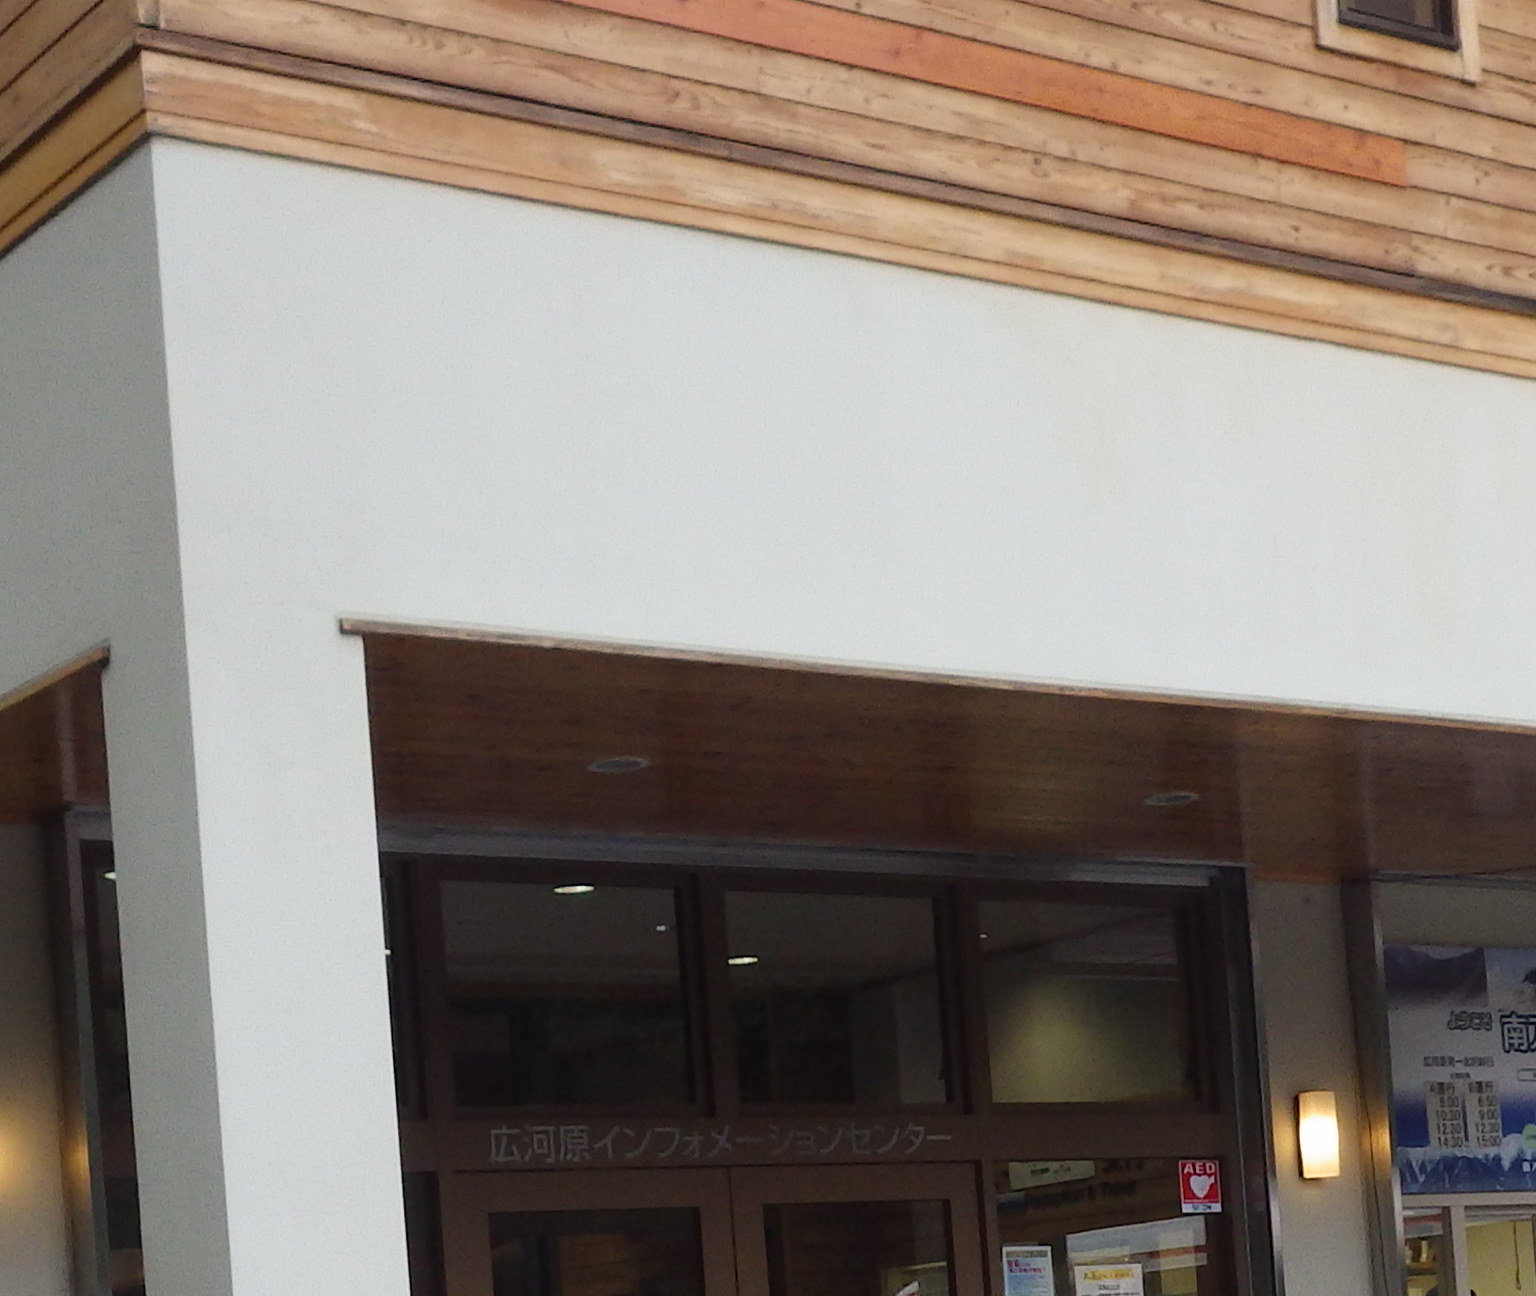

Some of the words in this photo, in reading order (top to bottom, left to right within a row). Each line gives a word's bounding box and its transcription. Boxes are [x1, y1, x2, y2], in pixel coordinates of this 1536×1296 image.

[489, 1122, 954, 1164] 広河原インフォメーションセンター
[1183, 1162, 1216, 1174] AED
